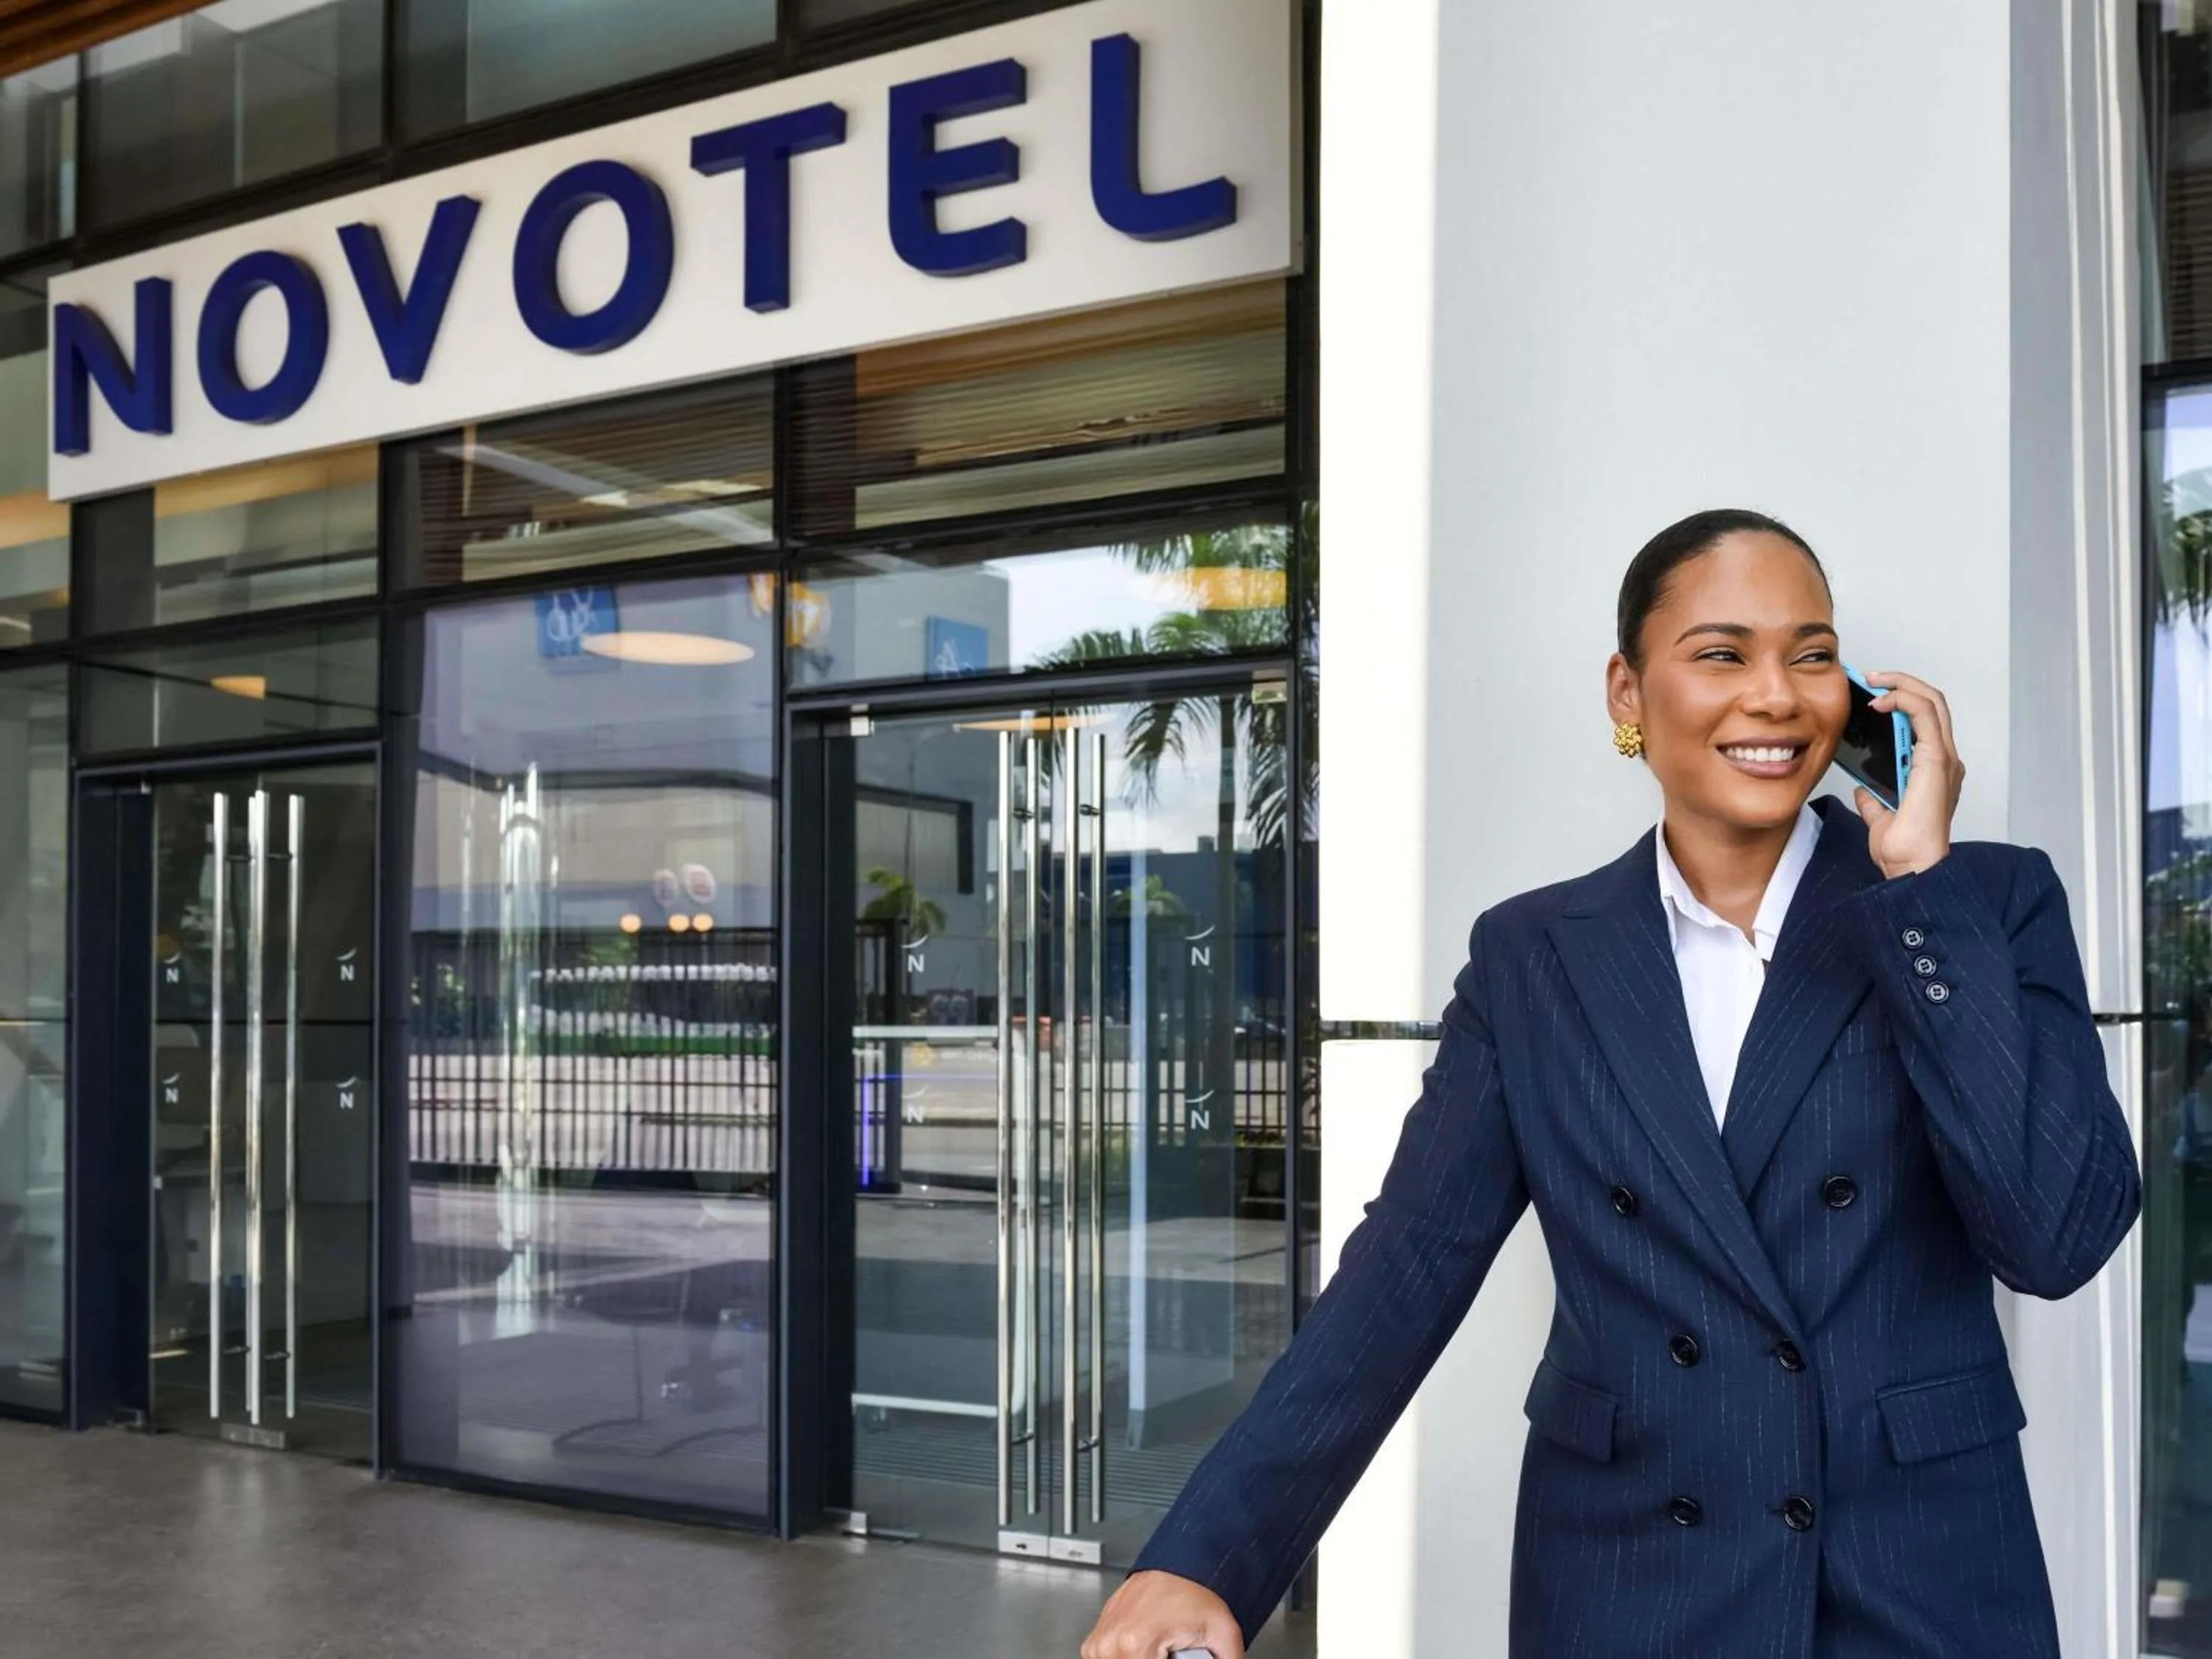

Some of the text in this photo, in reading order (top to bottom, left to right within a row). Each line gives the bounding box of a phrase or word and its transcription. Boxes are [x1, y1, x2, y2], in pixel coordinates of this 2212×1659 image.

[54, 32, 1237, 457] NOVOTEL
[908, 954, 925, 973] N
[1191, 947, 1210, 966] N
[166, 968, 179, 983] N
[341, 965, 354, 980] N
[165, 1088, 178, 1102] N
[340, 1092, 353, 1108] N
[907, 1105, 923, 1123] N
[1191, 1110, 1209, 1129] N
